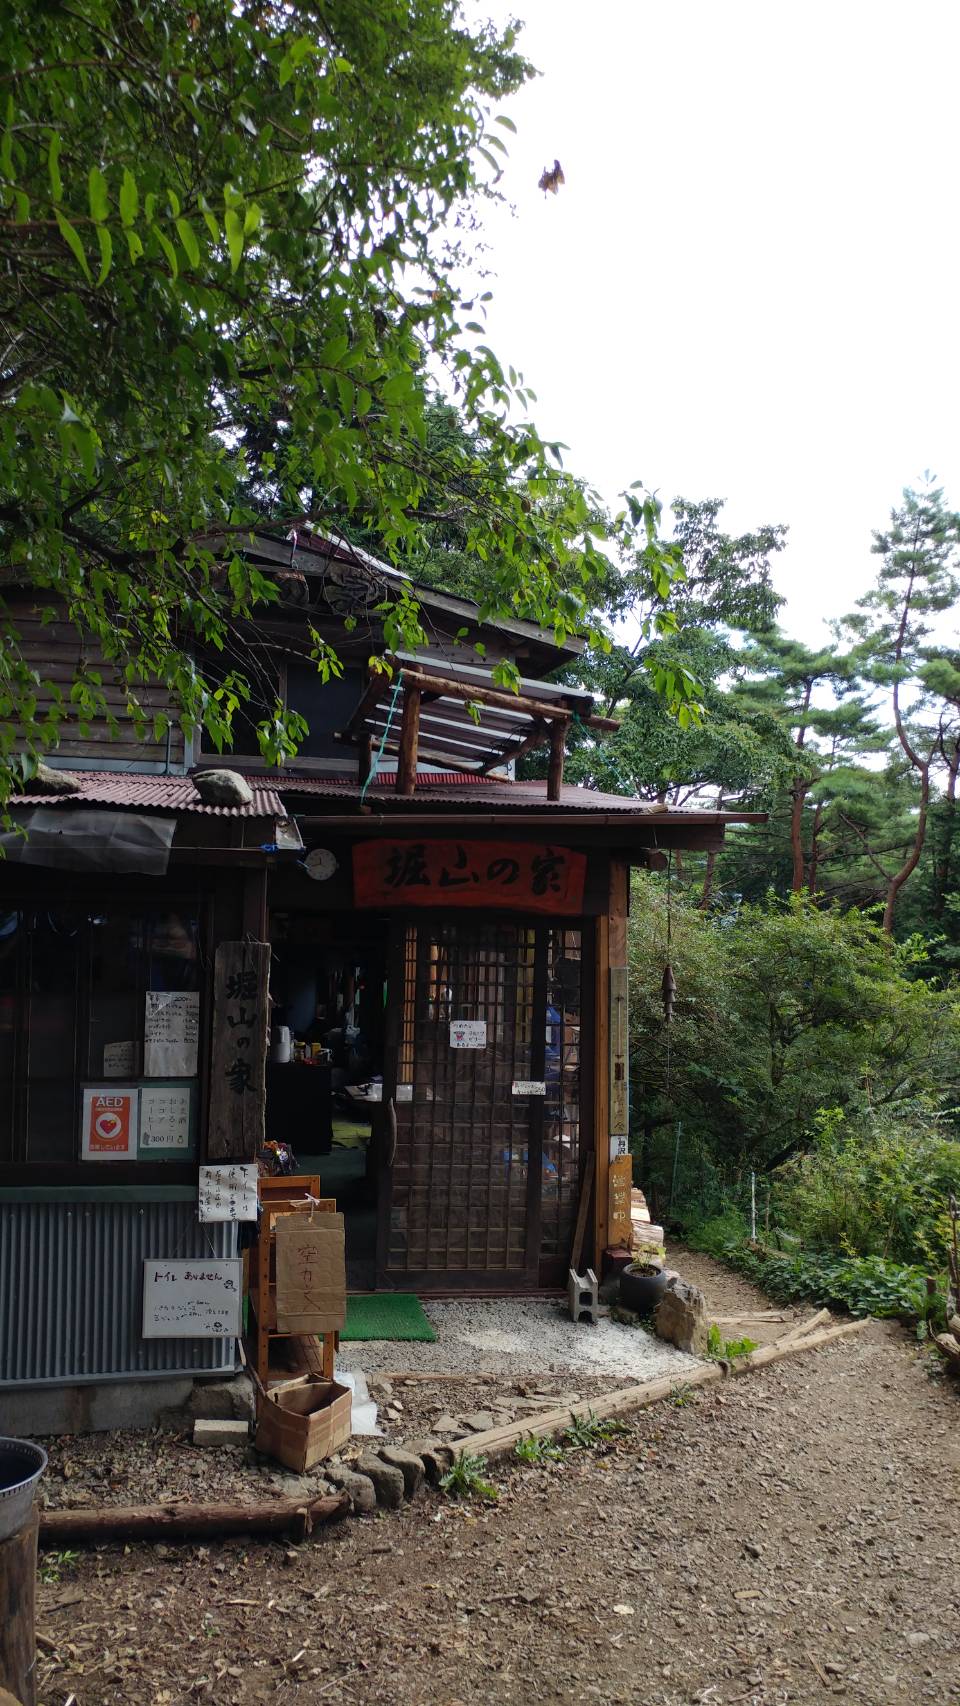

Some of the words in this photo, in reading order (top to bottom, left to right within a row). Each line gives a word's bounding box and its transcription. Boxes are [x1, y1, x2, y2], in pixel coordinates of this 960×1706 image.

[384, 844, 565, 895] 堀山の家
[225, 970, 258, 1095] 堀山の家
[96, 1097, 124, 1107] AED
[154, 1271, 177, 1283] トイレ
[184, 1271, 223, 1281] ありません
